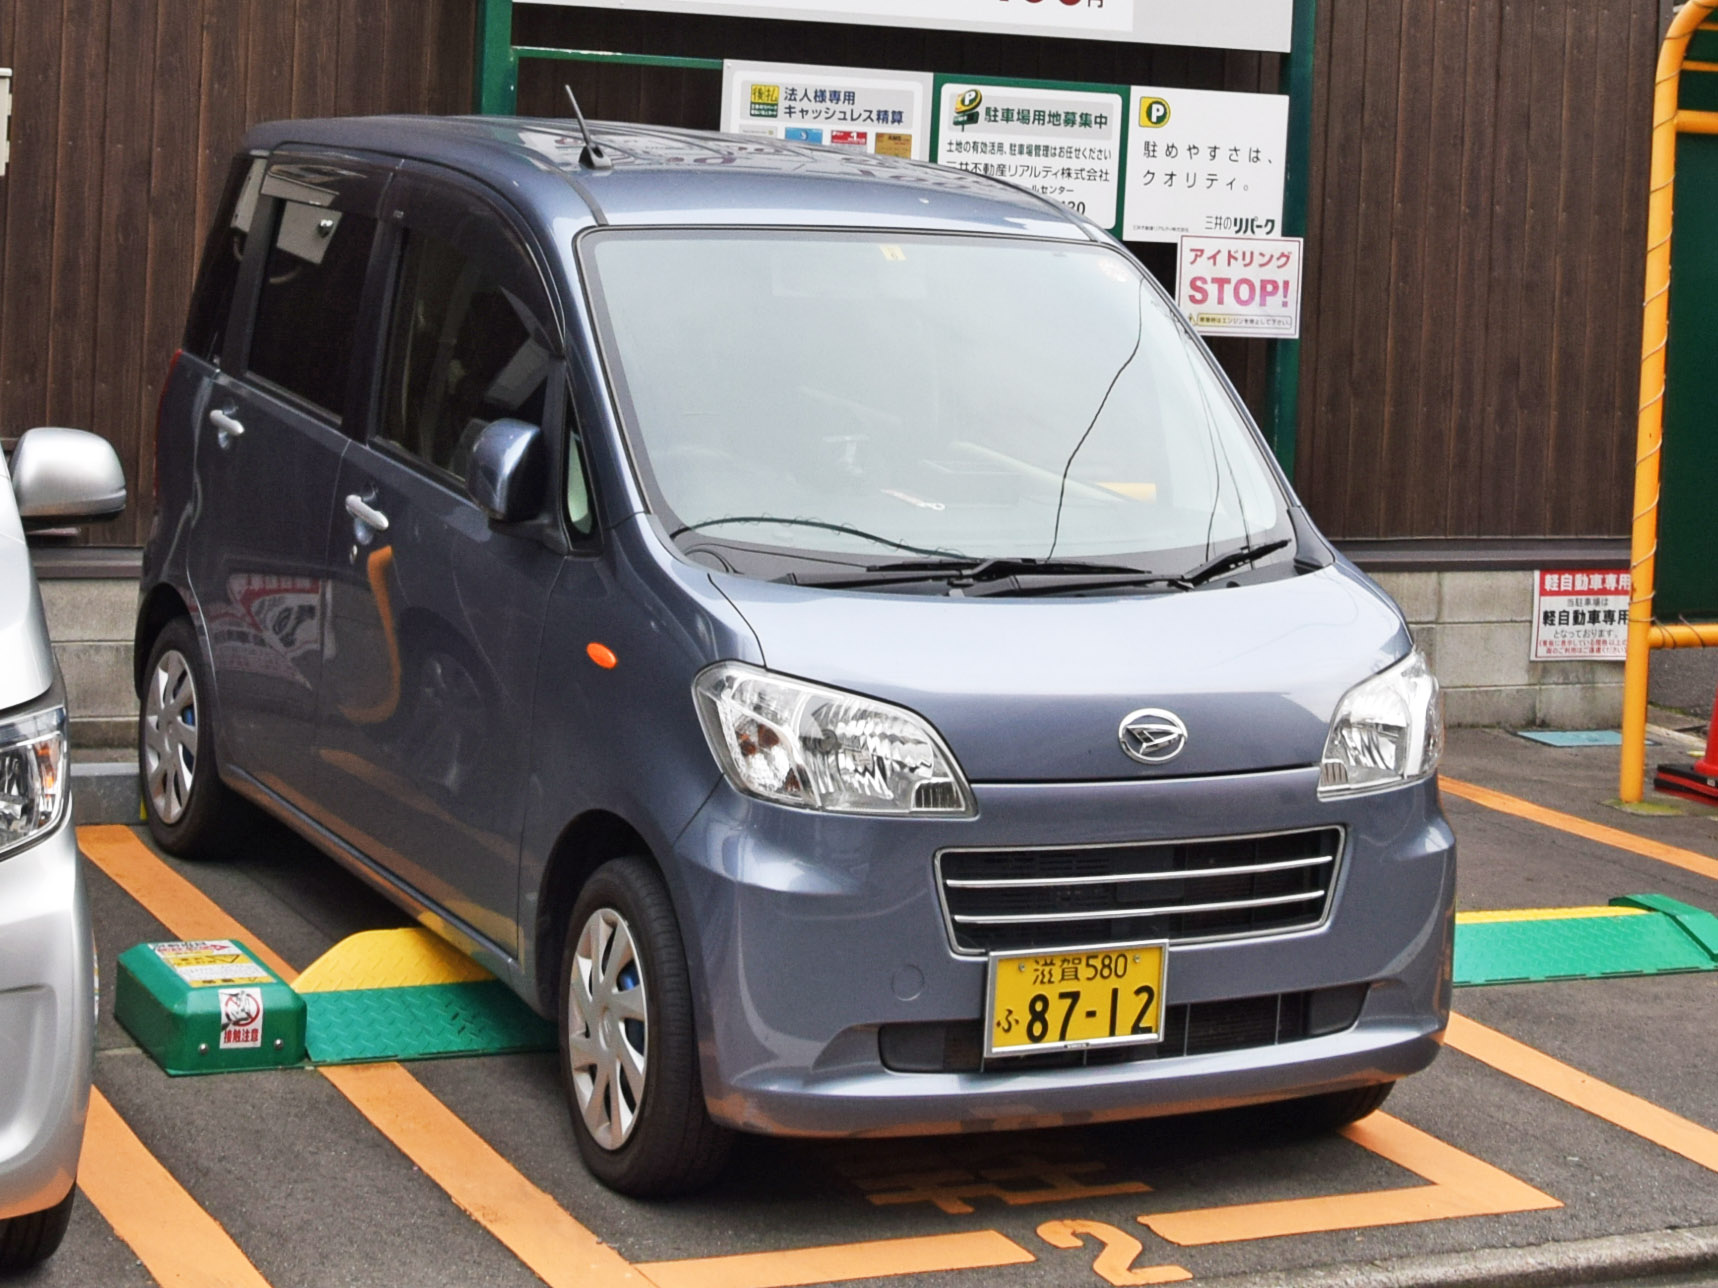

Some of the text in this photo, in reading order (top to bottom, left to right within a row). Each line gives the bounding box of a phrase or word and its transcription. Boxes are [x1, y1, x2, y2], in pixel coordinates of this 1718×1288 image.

[784, 86, 856, 106] 法人様専用
[784, 105, 904, 125] キャッシュレス精算
[984, 106, 1109, 129] 駐車場用地募集中
[1144, 141, 1273, 164] 駐めやすさは、
[1143, 169, 1249, 192] クオリティ。
[1205, 215, 1276, 235] 三井のリパーク
[1189, 248, 1293, 270] アイドリング
[1188, 276, 1290, 308] STOP!
[1026, 984, 1155, 1044] 87-12
